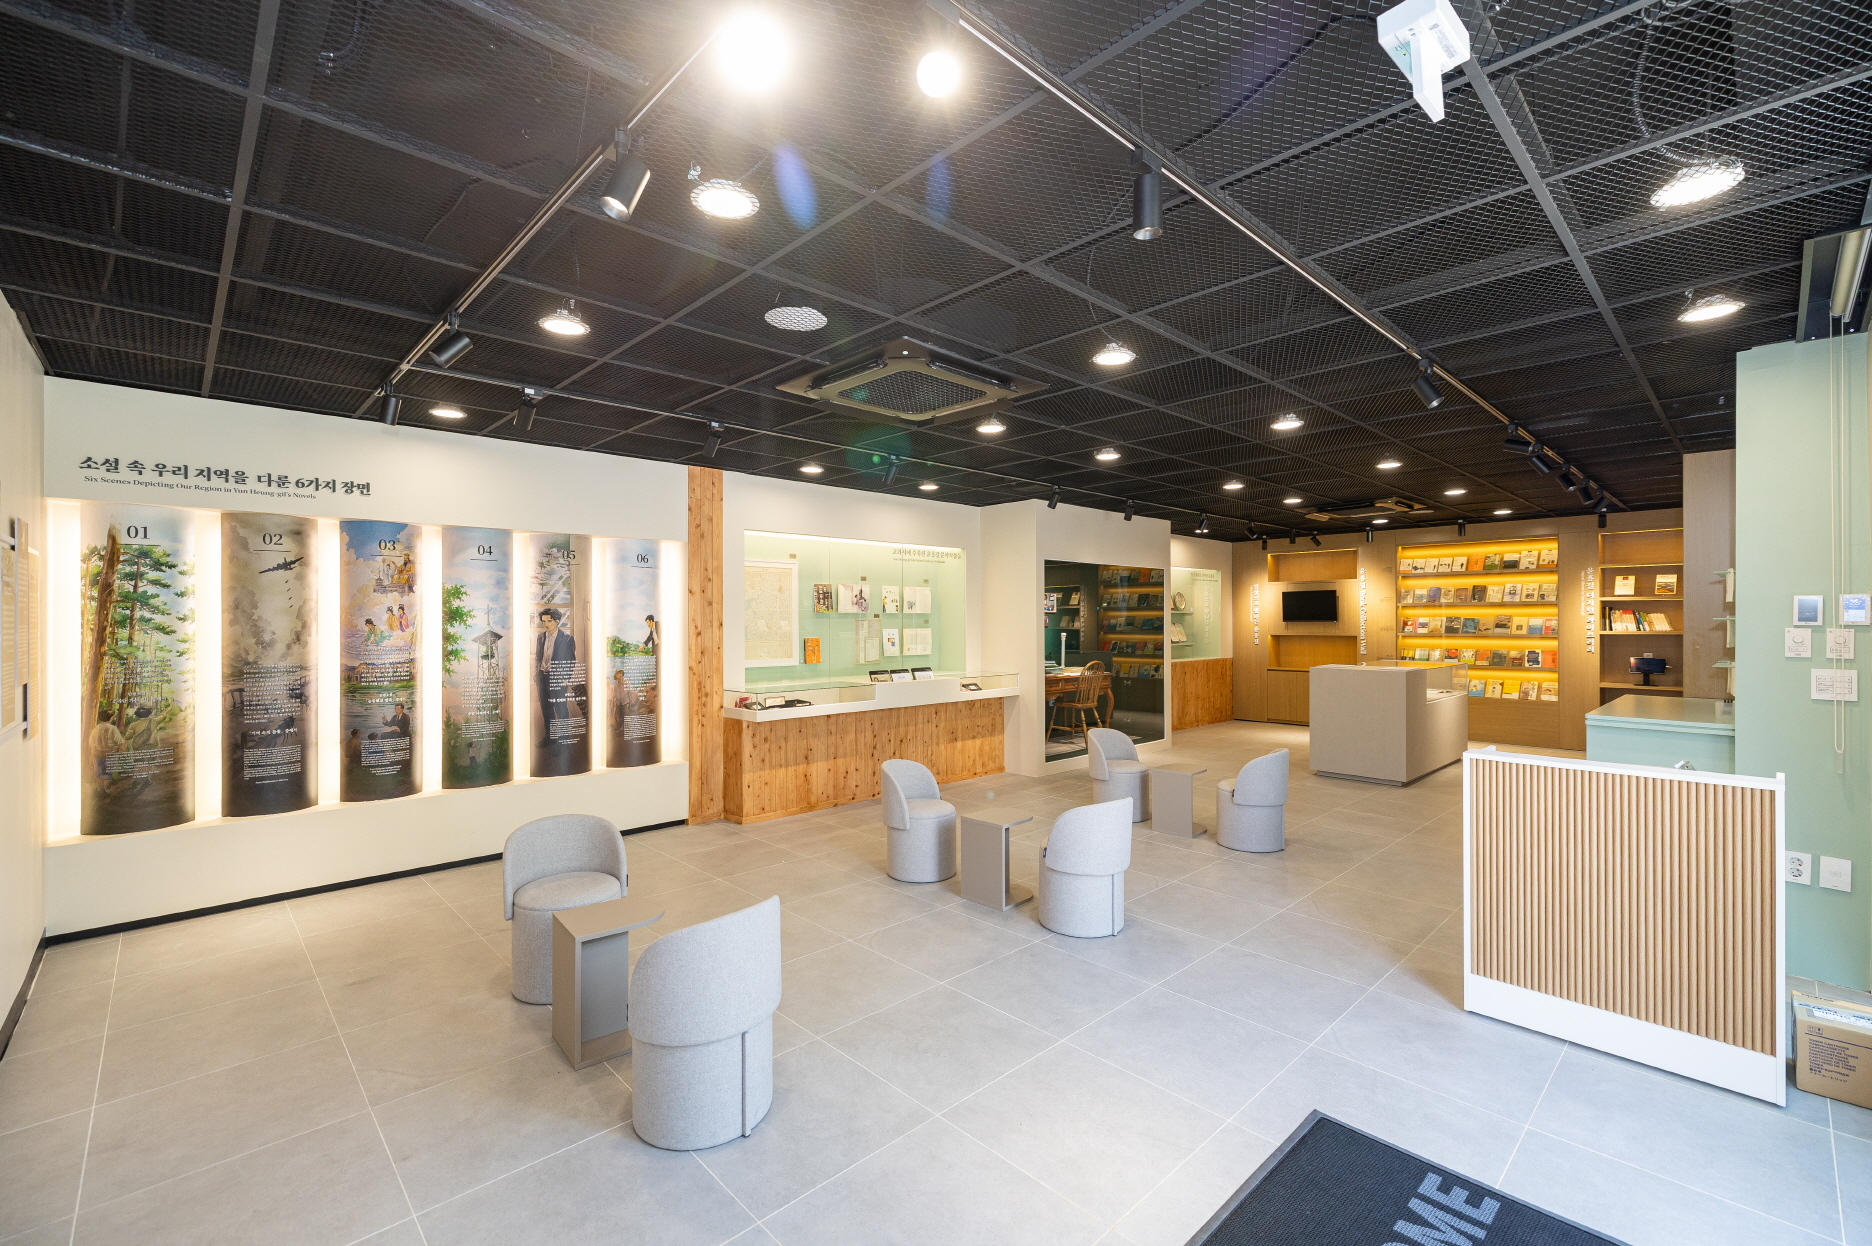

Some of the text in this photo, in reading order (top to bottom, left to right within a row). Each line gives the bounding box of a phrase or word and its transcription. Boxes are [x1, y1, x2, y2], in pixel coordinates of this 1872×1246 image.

[79, 456, 371, 496] 소설 속 우리 지역을 다룬 6가지 장면
[100, 476, 131, 485] Scenes
[133, 479, 175, 490] Depicting
[194, 484, 222, 493] Region
[126, 525, 150, 540] 01
[262, 532, 284, 546] 02
[378, 538, 396, 552] 03
[477, 544, 493, 556] 04
[562, 549, 576, 560] 05
[636, 553, 649, 564] 06
